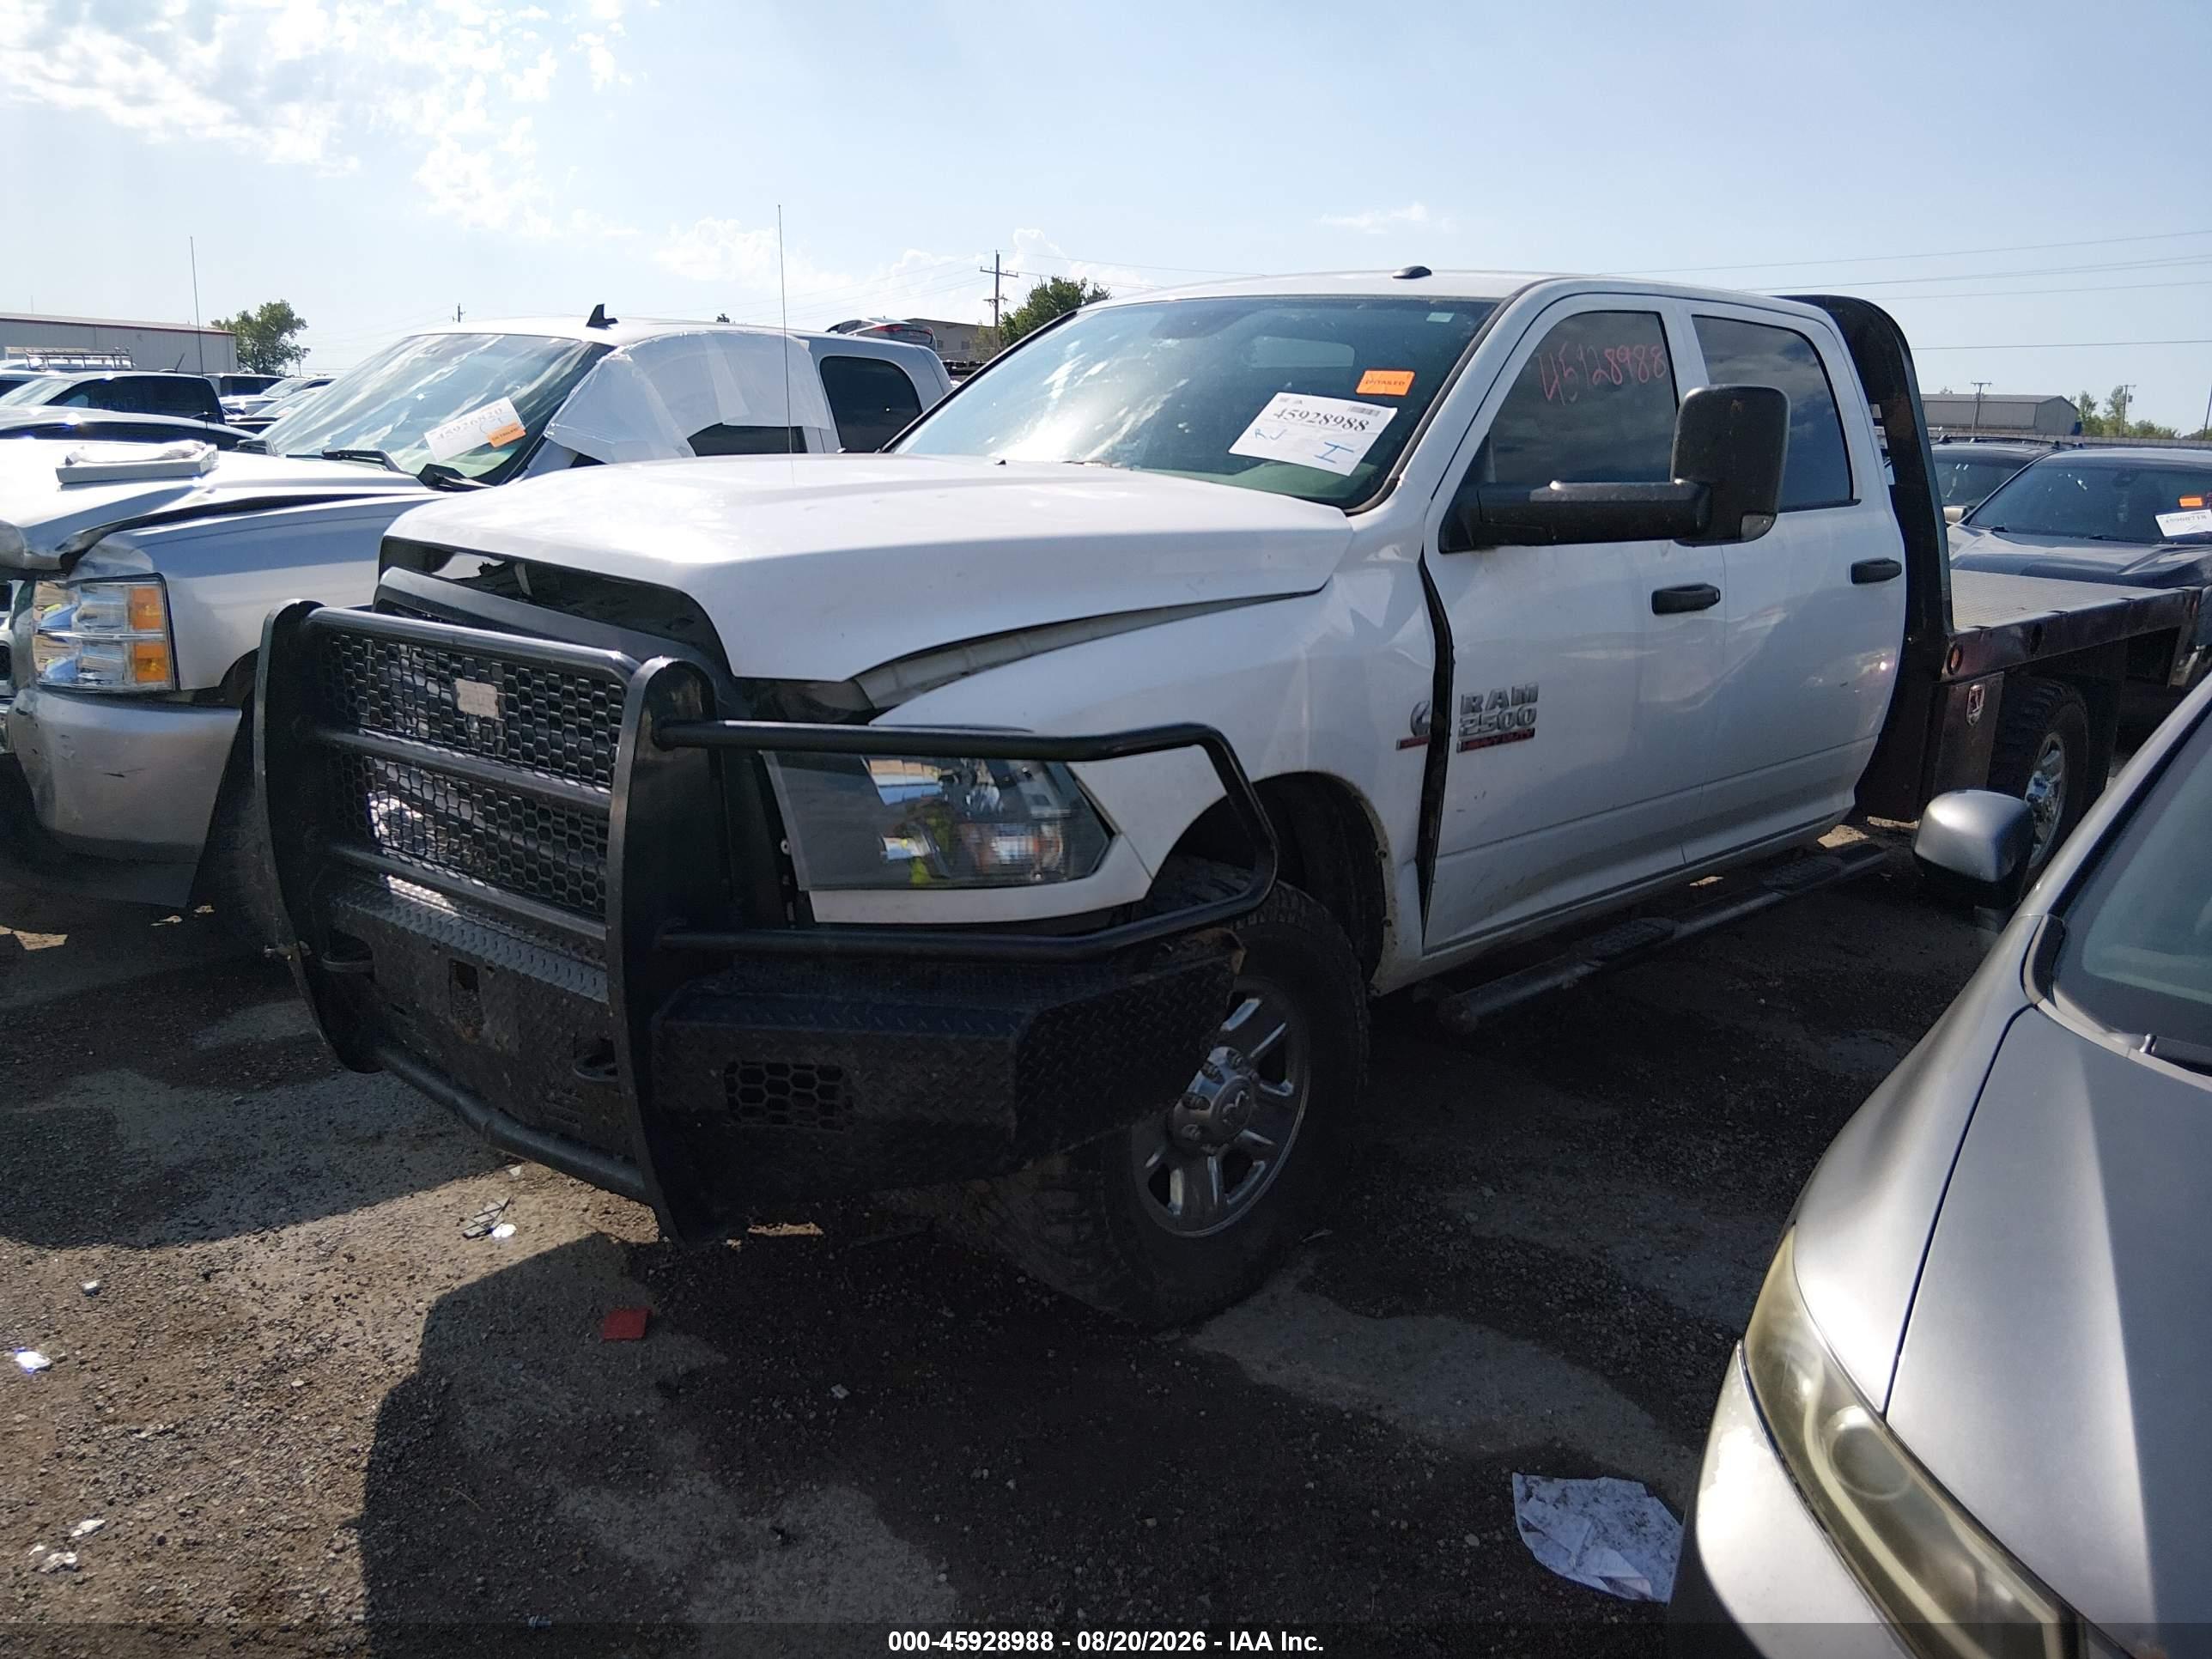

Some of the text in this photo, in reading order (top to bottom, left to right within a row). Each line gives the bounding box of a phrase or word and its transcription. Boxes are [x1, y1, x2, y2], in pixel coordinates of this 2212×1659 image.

[1273, 407, 1370, 432] 45928988
[1460, 682, 1540, 715] RAM
[1458, 705, 1538, 738] 2500
